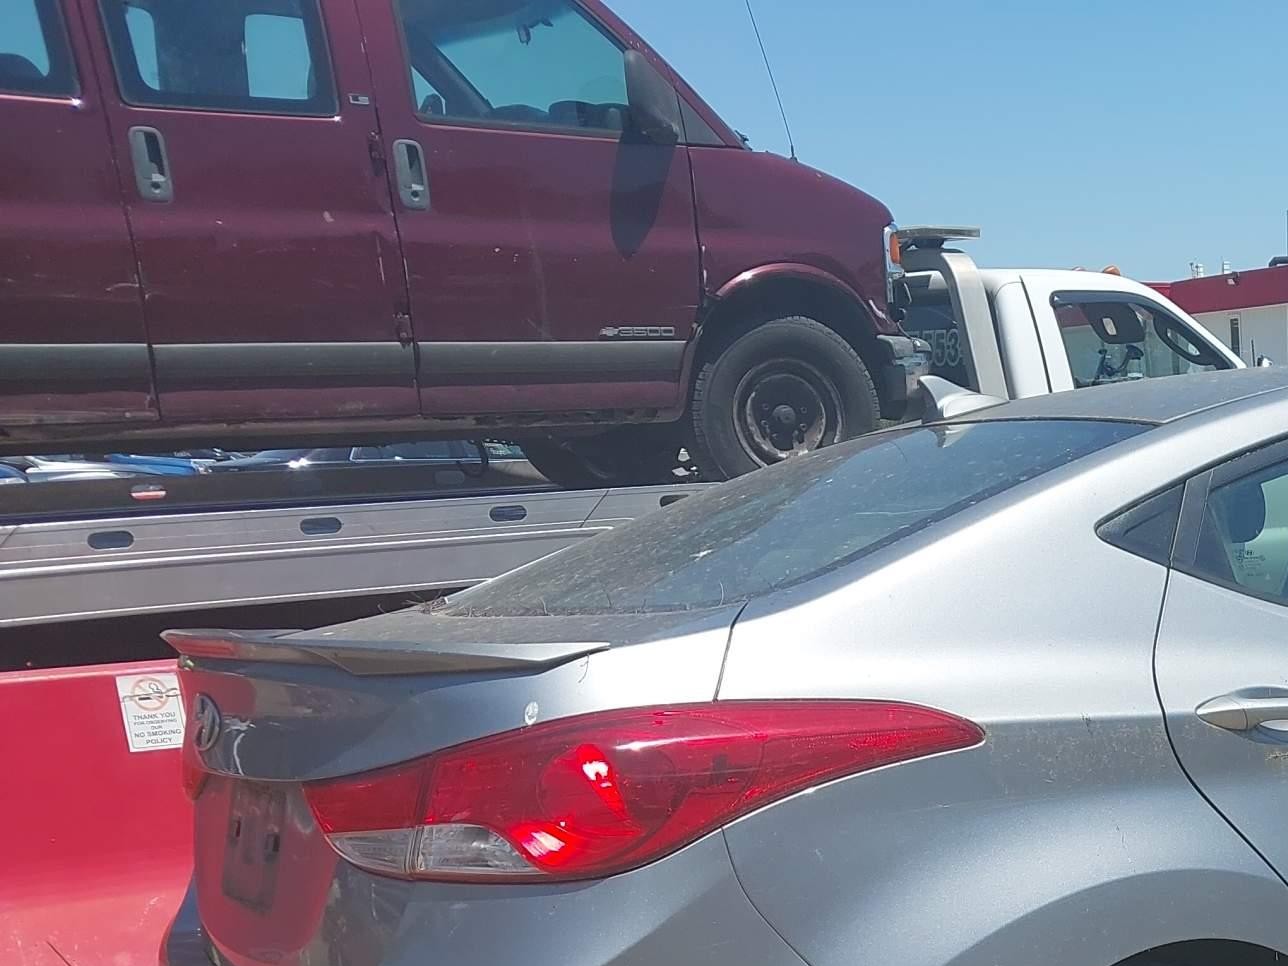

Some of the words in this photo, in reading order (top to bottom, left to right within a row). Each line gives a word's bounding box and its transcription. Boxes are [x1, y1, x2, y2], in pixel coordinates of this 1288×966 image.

[618, 326, 675, 337] 3500
[133, 712, 159, 721] THANK
[160, 711, 176, 719] YOU
[146, 728, 182, 737] SMOKING
[145, 737, 173, 745] POLICY
